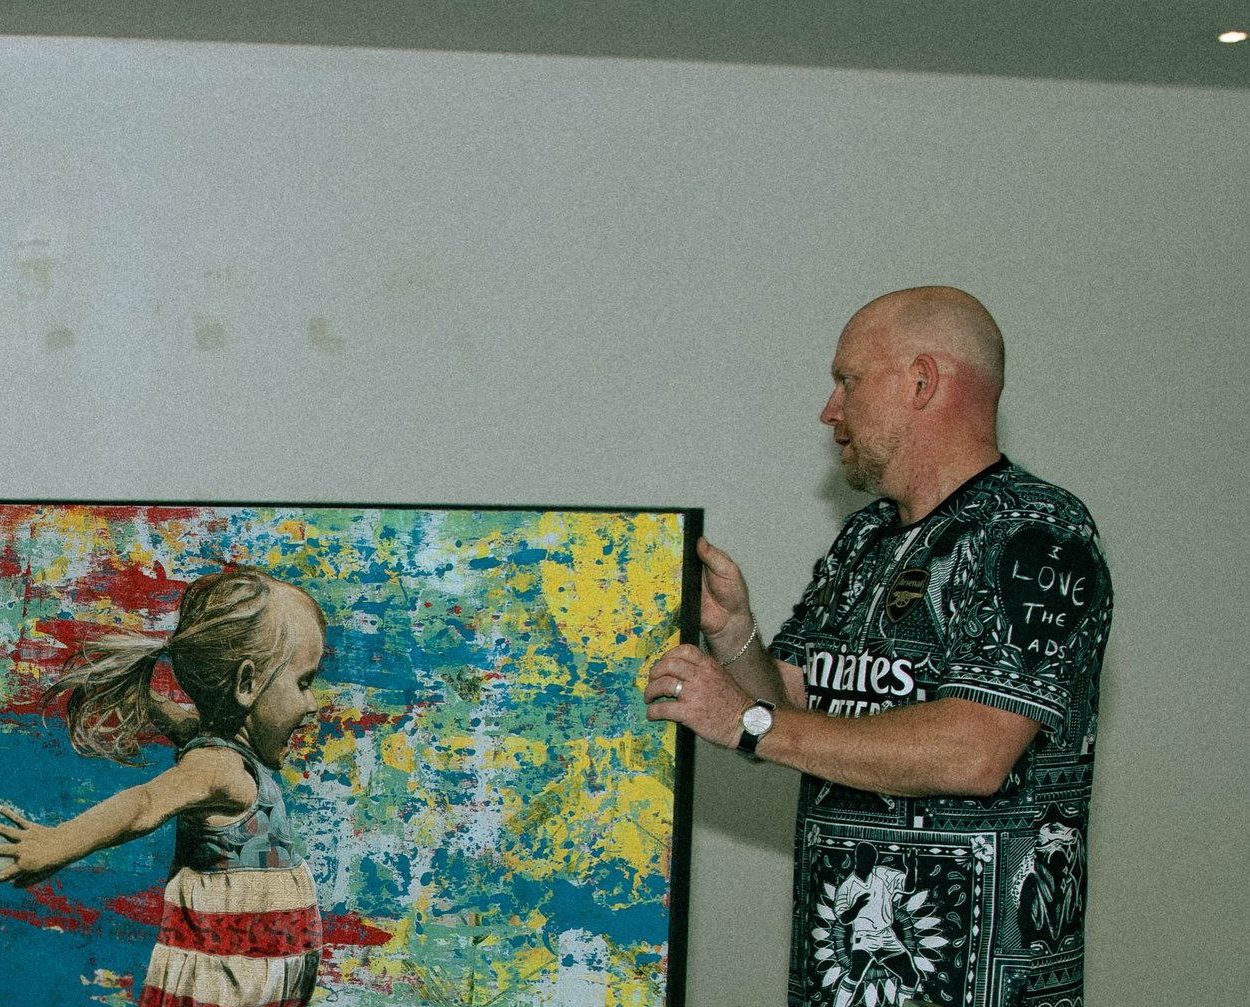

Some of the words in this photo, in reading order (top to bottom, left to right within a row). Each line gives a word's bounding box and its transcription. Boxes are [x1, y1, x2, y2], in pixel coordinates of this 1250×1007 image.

[1048, 545, 1063, 560] I
[1012, 560, 1086, 606] LOVE
[1022, 602, 1067, 627] THE
[1004, 624, 1067, 659] LADS
